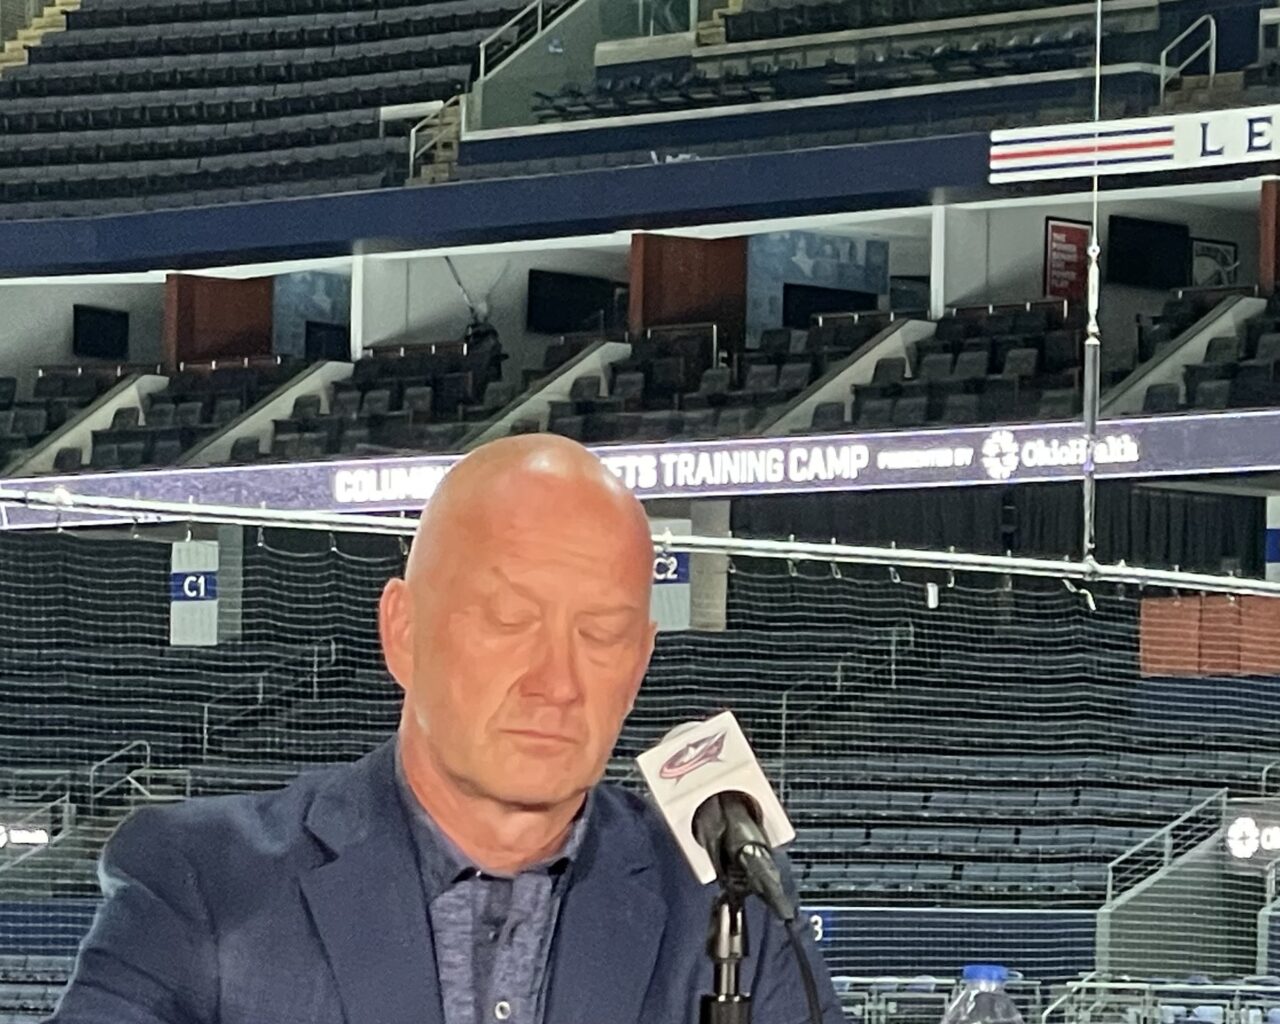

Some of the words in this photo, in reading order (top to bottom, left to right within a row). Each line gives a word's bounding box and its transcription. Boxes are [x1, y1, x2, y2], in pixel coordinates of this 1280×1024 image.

[660, 448, 785, 487] TRAINING
[788, 444, 870, 482] CAMP
[653, 556, 678, 580] C2
[183, 575, 205, 598] C1
[810, 914, 823, 941] 3
